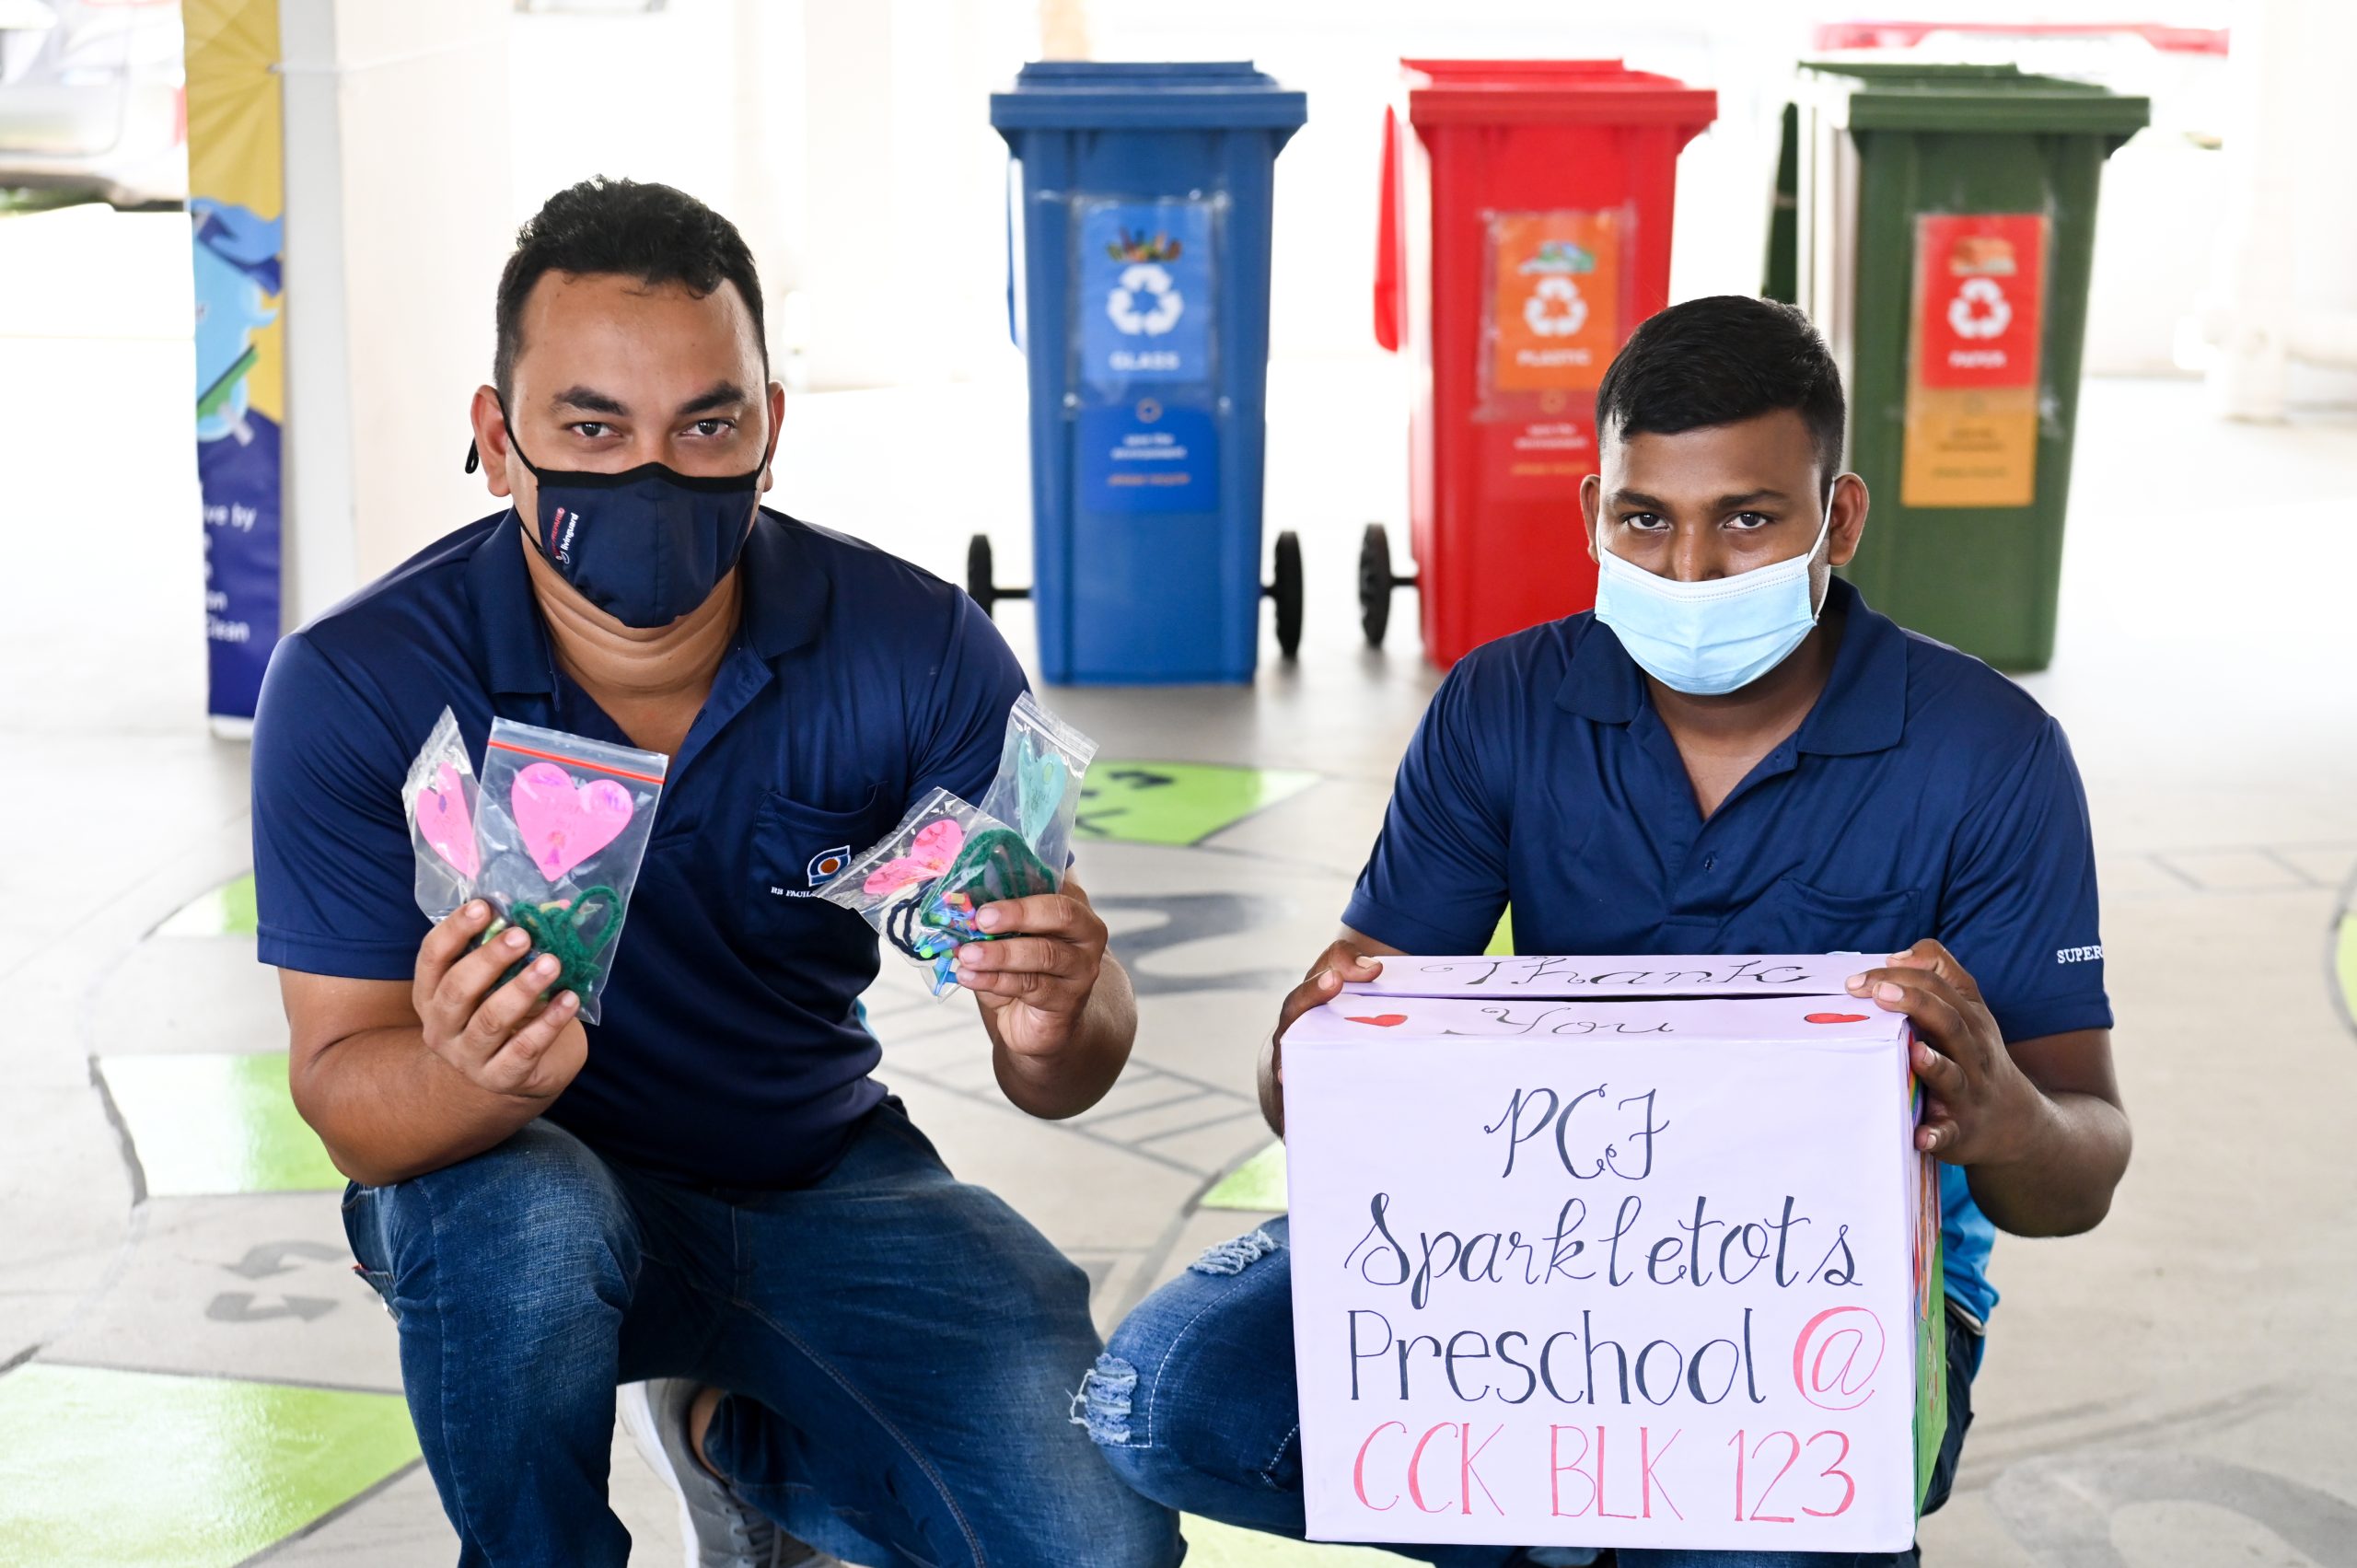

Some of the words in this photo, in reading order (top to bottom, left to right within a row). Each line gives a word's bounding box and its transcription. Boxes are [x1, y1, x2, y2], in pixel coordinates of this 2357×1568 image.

[1421, 955, 1812, 986] Thank
[2057, 946, 2104, 964] SUPER
[1443, 1006, 1674, 1036] You
[1343, 1191, 1864, 1310] Sparkletots
[1347, 1307, 1767, 1406] Preschool
[1792, 1305, 1886, 1411] @
[1353, 1420, 1505, 1516] CCK
[1549, 1423, 1684, 1521] BLK
[1727, 1428, 1856, 1523] 123
